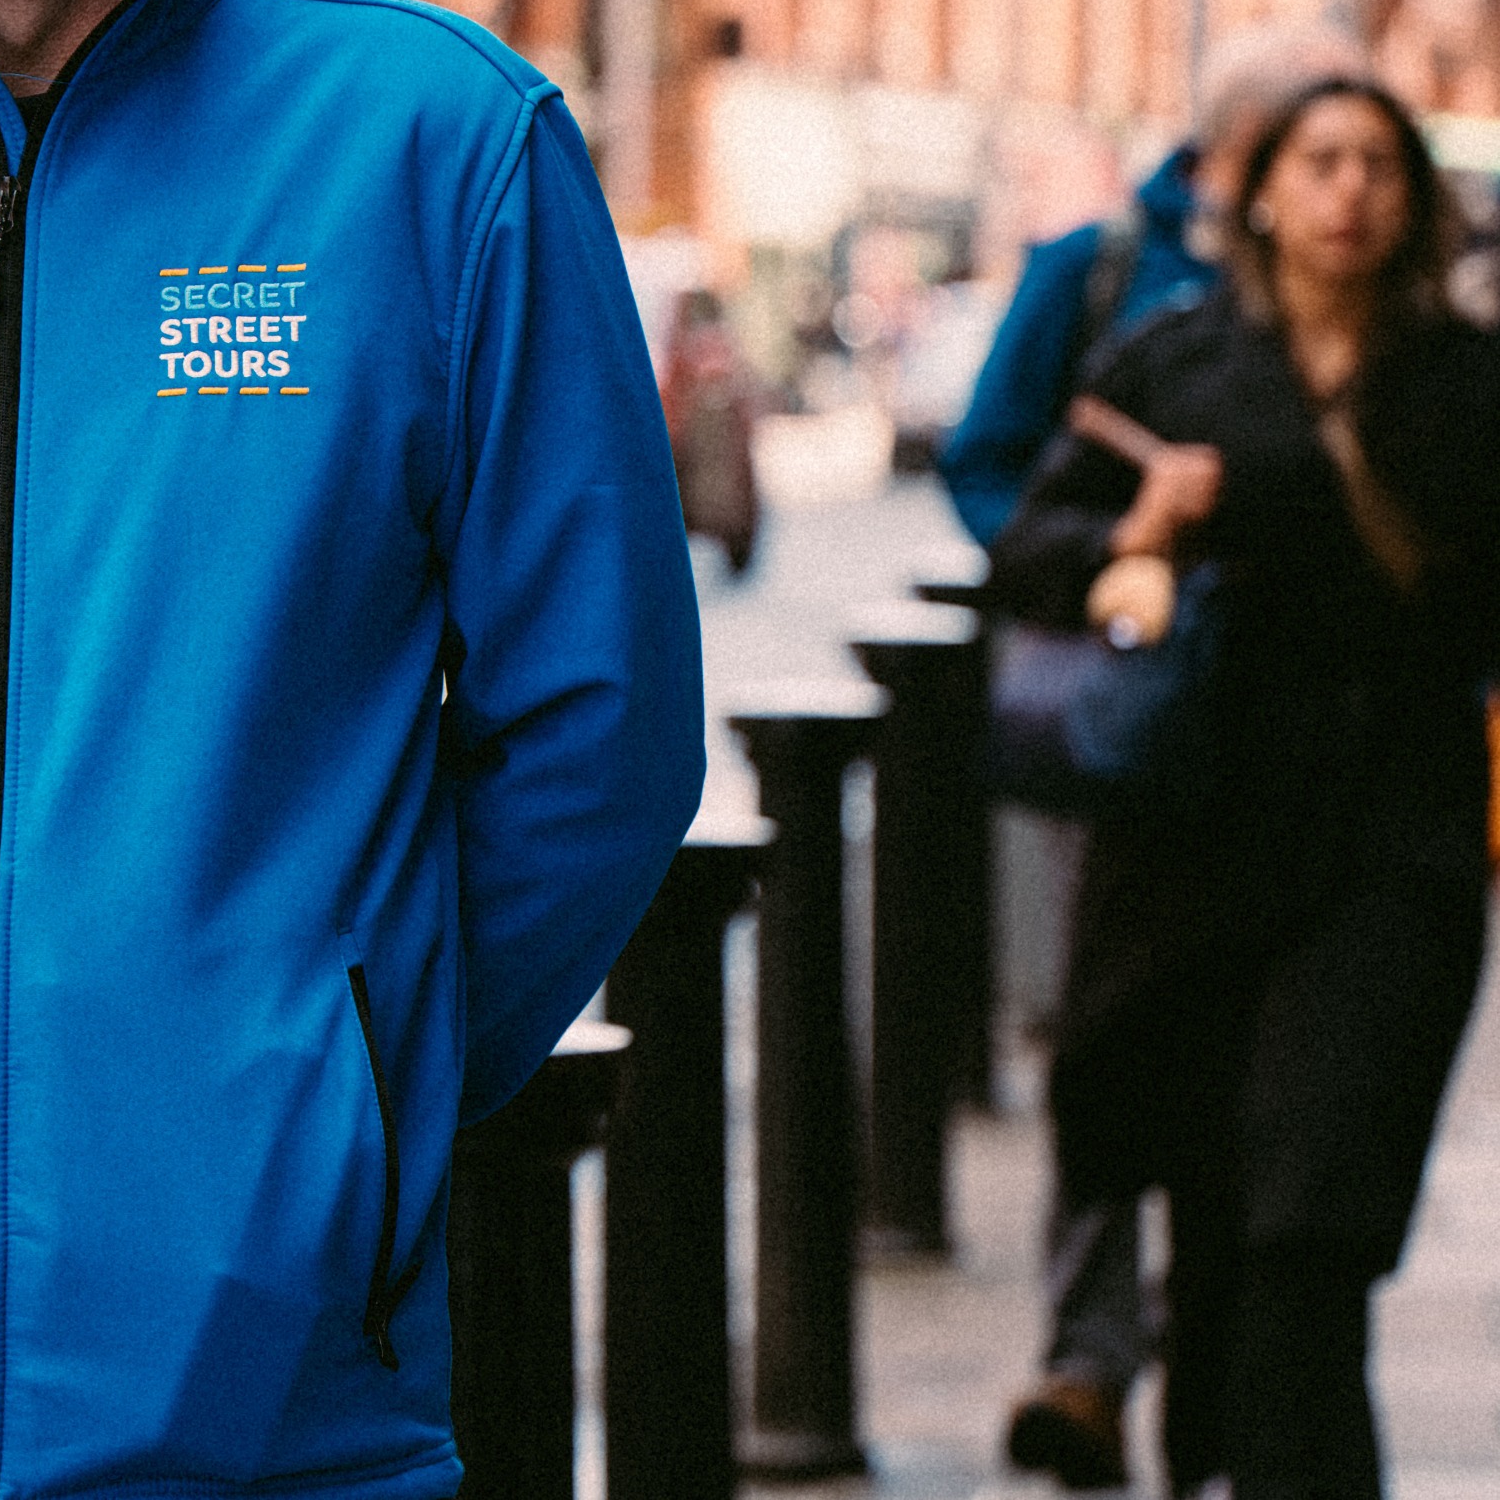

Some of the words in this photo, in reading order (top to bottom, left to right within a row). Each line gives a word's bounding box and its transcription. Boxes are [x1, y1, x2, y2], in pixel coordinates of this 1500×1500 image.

[160, 281, 306, 312] SECRET
[159, 315, 307, 346] STREET
[159, 349, 291, 379] TOURS
